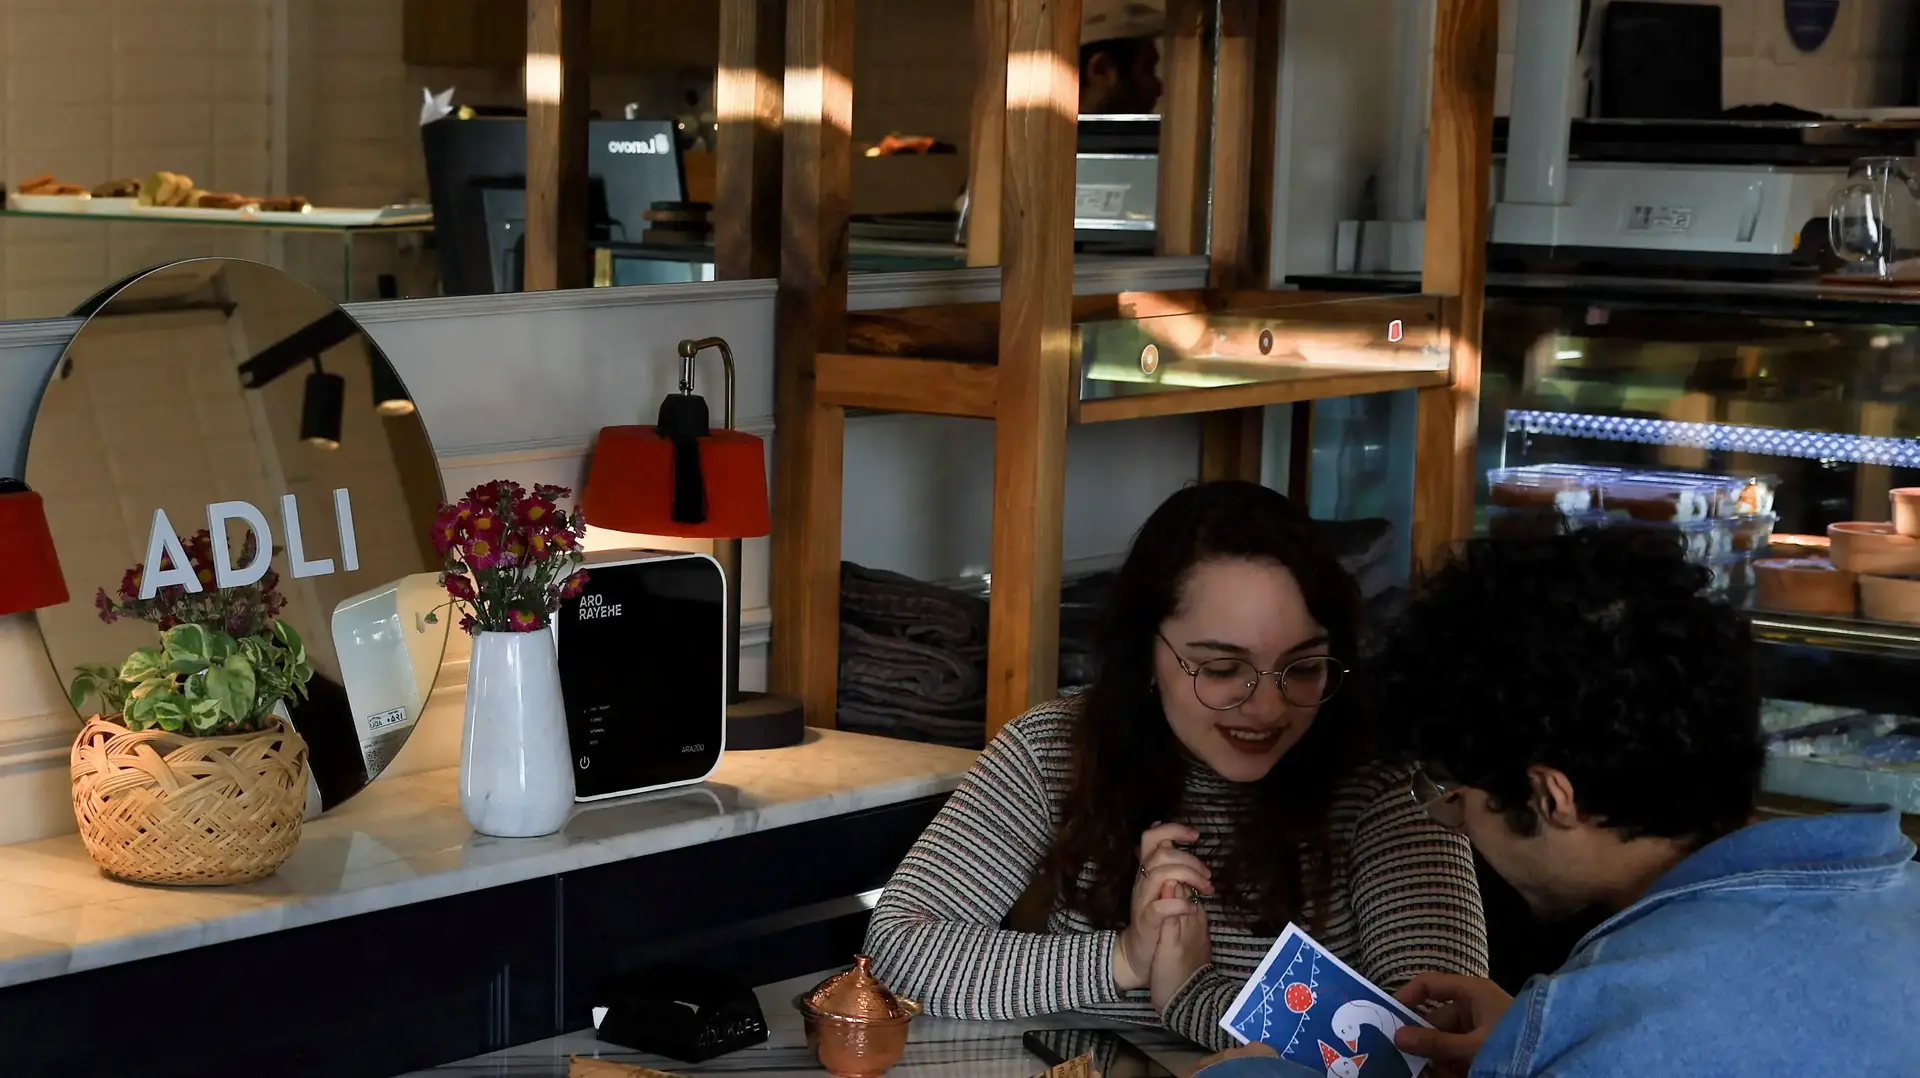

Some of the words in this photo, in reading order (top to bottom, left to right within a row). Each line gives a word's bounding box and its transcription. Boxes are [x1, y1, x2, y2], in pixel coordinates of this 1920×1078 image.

[138, 488, 359, 600] ADLI
[579, 594, 603, 608] ARO
[579, 604, 622, 620] RAYEHE
